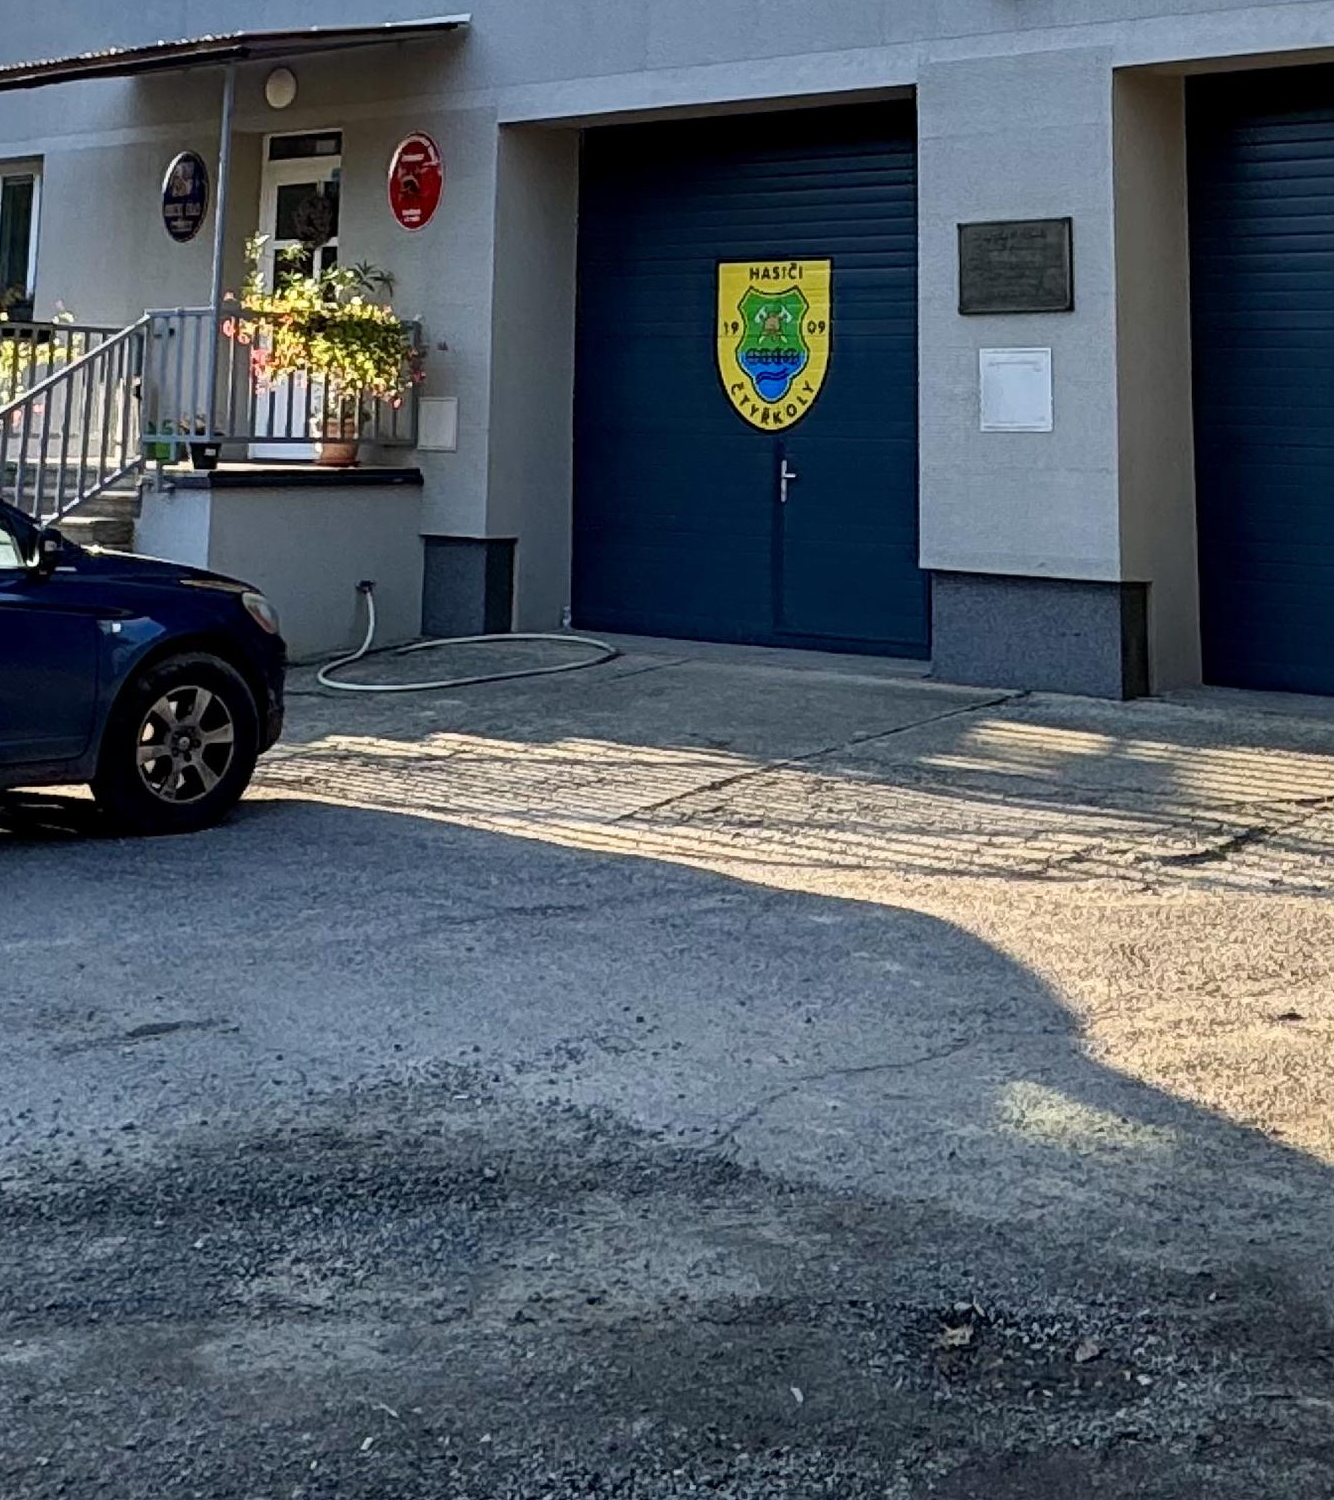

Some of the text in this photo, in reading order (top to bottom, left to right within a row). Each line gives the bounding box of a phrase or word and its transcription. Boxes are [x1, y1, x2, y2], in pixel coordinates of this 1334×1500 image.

[748, 262, 803, 282] HASIČI
[723, 320, 826, 337] 19 09
[730, 380, 815, 426] ČTYŘKOLY
